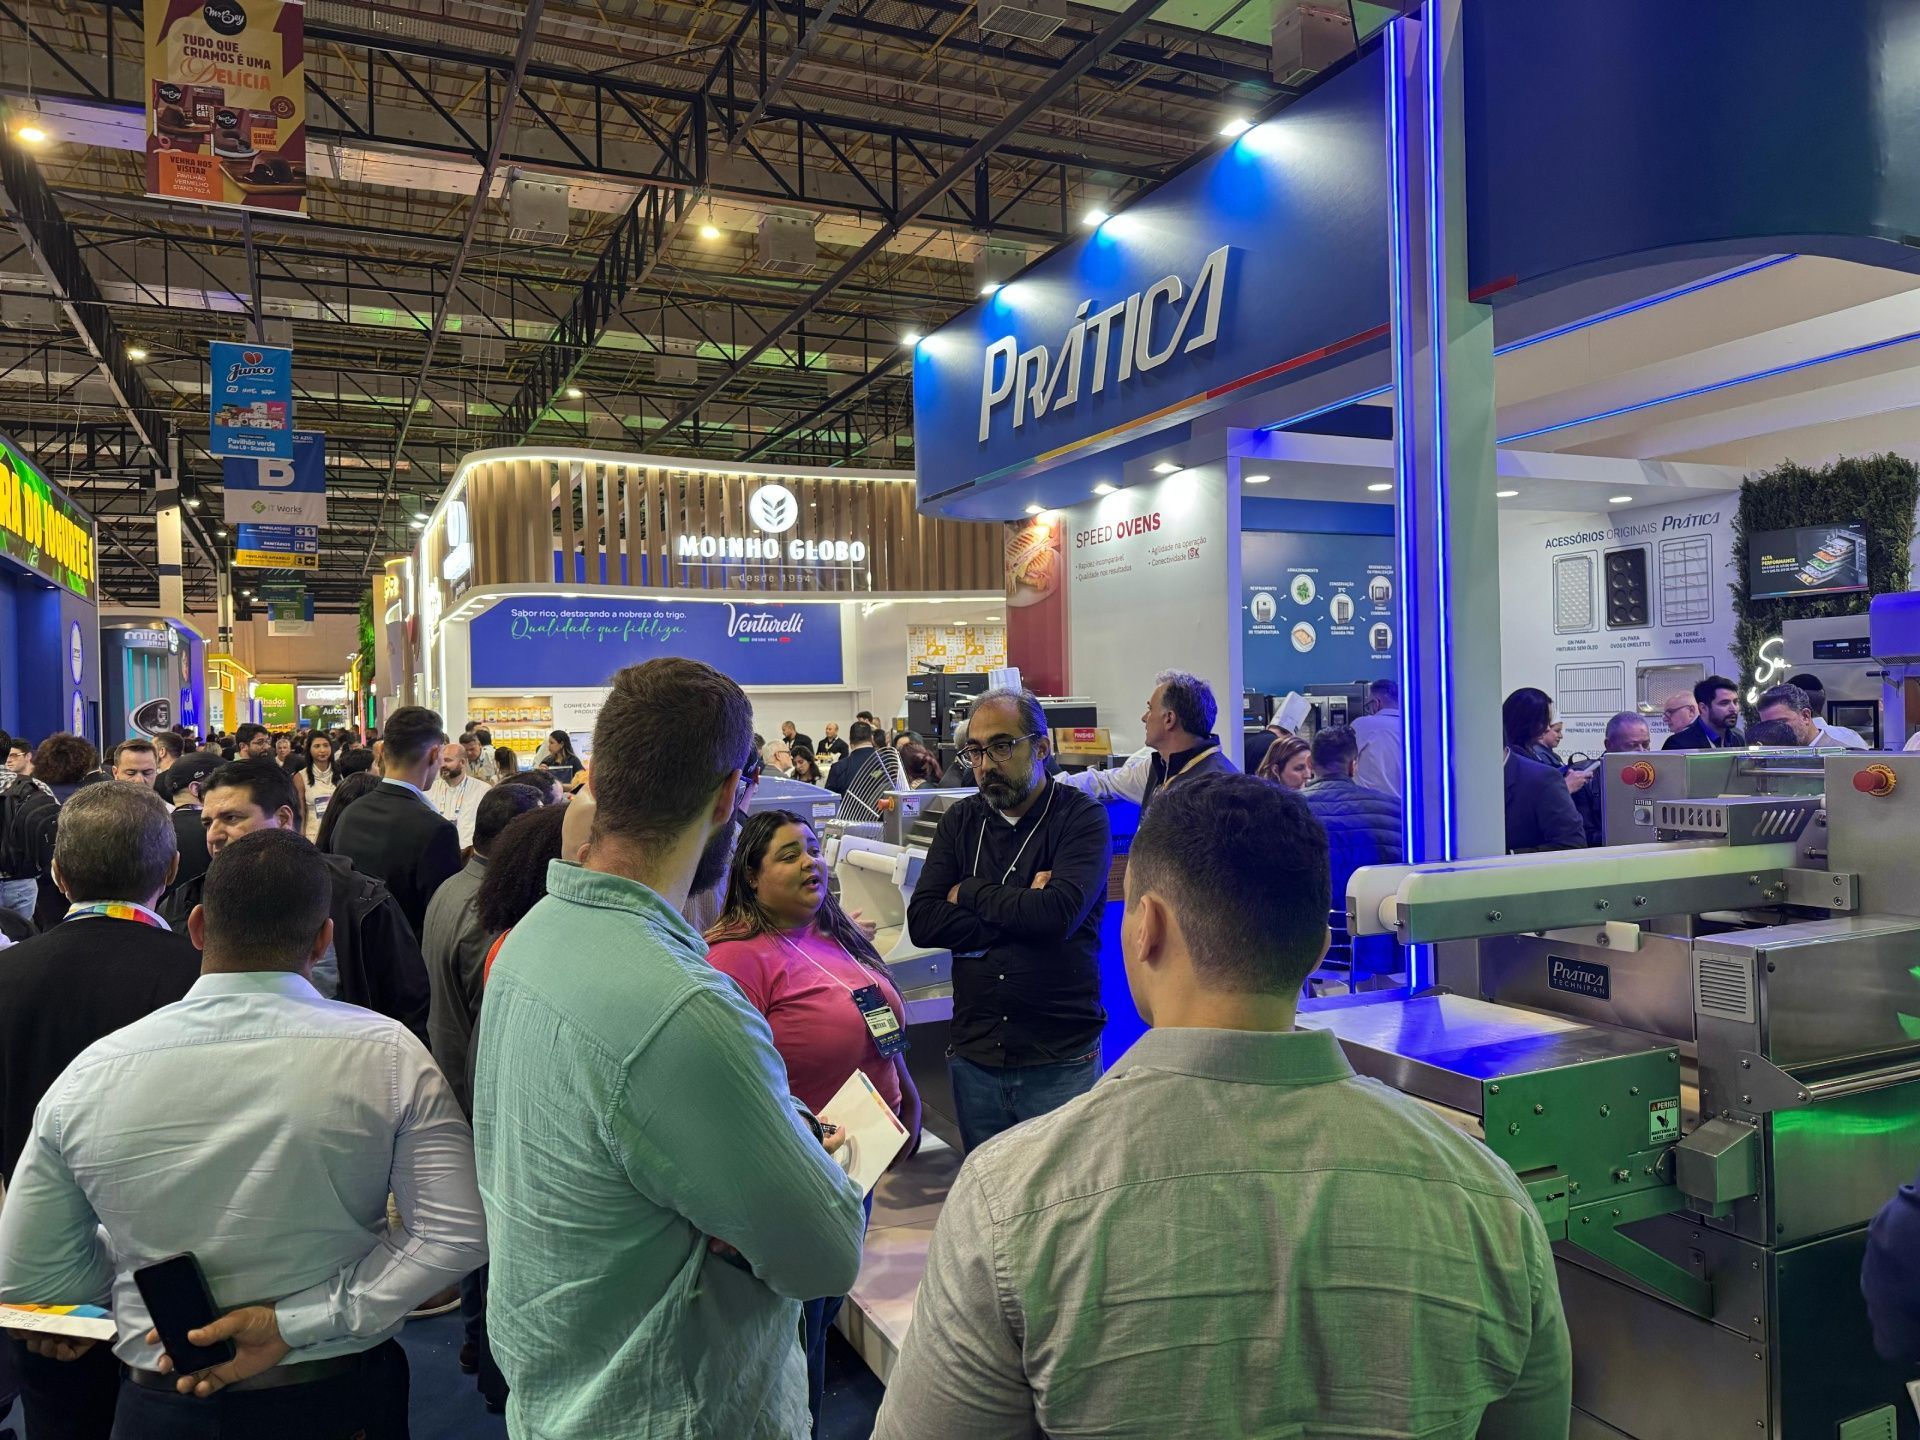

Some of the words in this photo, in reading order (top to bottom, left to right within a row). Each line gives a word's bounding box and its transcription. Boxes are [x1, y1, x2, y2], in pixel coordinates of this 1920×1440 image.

[183, 34, 213, 48] TUDO
[216, 40, 239, 52] QUE
[183, 46, 234, 64] CRIAMOS
[237, 54, 244, 65] É
[246, 57, 271, 70] UMA
[170, 156, 196, 166] VENHA
[197, 160, 212, 168] NOS
[176, 164, 206, 175] VISITAR
[174, 179, 209, 188] VERMELHO
[227, 363, 275, 382] Junco
[258, 459, 295, 488] B
[277, 505, 303, 514] Works
[24, 482, 42, 549] DO
[44, 499, 88, 580] IOGURTE
[1076, 525, 1112, 549] SPEED
[1116, 512, 1161, 539] OVENS
[1545, 531, 1605, 549] ACESSÓRIOS
[1606, 522, 1657, 540] ORIGINAIS
[678, 534, 780, 559] MOINHO
[789, 538, 867, 562] GLOBO
[738, 574, 775, 583] desde
[781, 575, 812, 583] 1954
[511, 608, 538, 618] Sabor
[539, 609, 559, 619] rico,
[560, 609, 610, 619] destacando
[611, 611, 618, 619] a
[619, 610, 652, 619] nobreza
[653, 611, 664, 619] do
[665, 610, 688, 621] trigo.
[723, 602, 804, 638] Venturelli
[511, 615, 595, 640] Qualidade
[597, 622, 622, 642] que
[622, 618, 688, 643] fideliza.
[1553, 978, 1606, 995] TECHNIPAN
